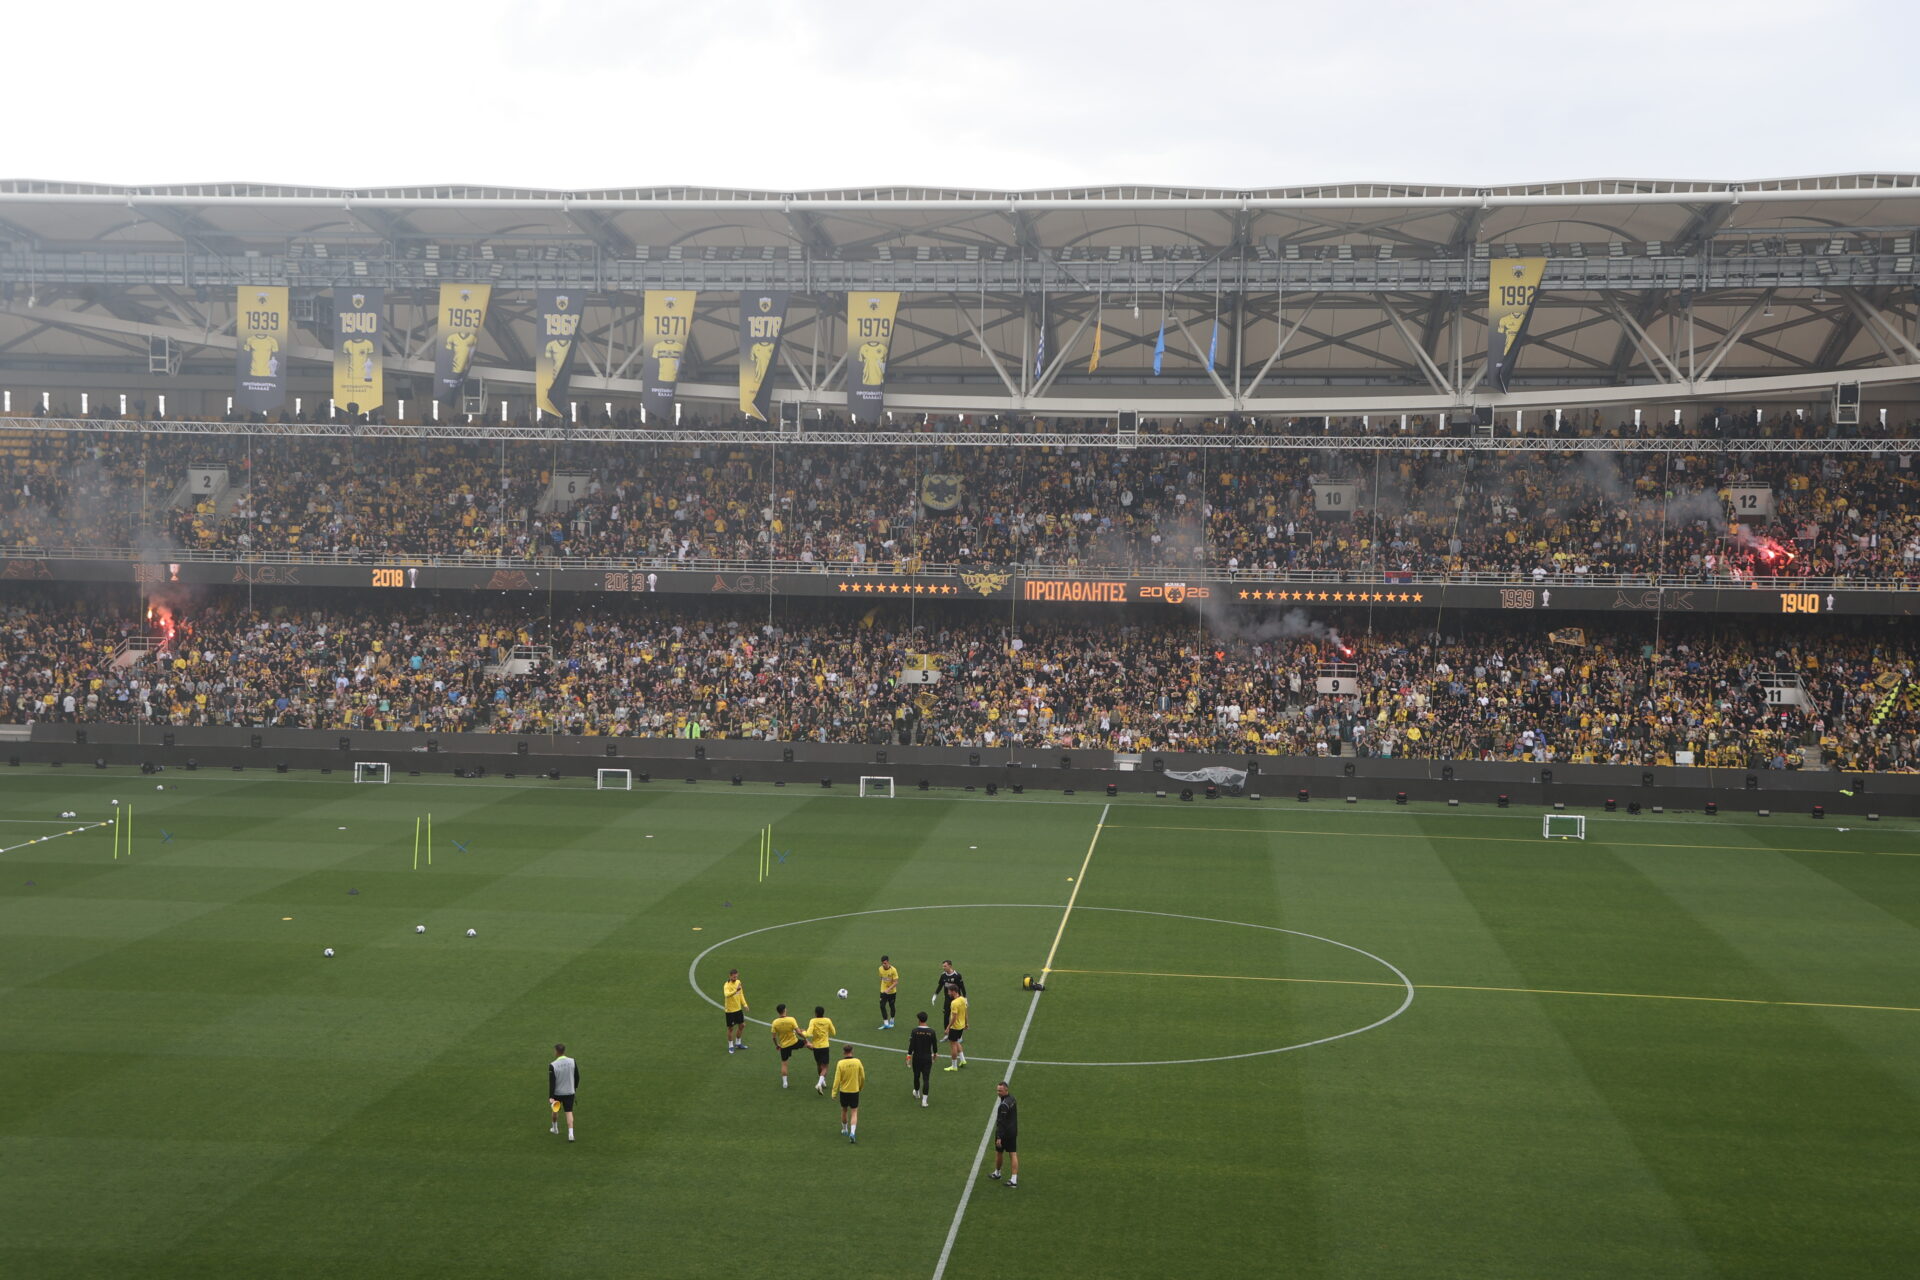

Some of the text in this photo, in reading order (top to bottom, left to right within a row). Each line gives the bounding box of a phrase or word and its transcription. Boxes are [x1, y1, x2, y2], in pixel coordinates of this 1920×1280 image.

[1499, 286, 1537, 306] 1992
[246, 311, 279, 331] 1939
[340, 312, 377, 333] 1940
[448, 308, 482, 328] 1963
[654, 316, 687, 336] 1971
[857, 318, 890, 337] 1979
[203, 475, 212, 489] 2
[567, 481, 576, 494] 6
[1325, 492, 1342, 505] 10
[1739, 494, 1757, 509] 12
[372, 569, 404, 588] 2018
[604, 572, 645, 591] 2023
[1025, 580, 1127, 602] ΠΡΩΤΑΘΛΗΤΕΣ
[1500, 588, 1535, 609] 1939
[1780, 593, 1820, 613] 1940
[921, 670, 929, 682] 5
[1331, 680, 1340, 692] 9
[1768, 689, 1782, 702] 11
